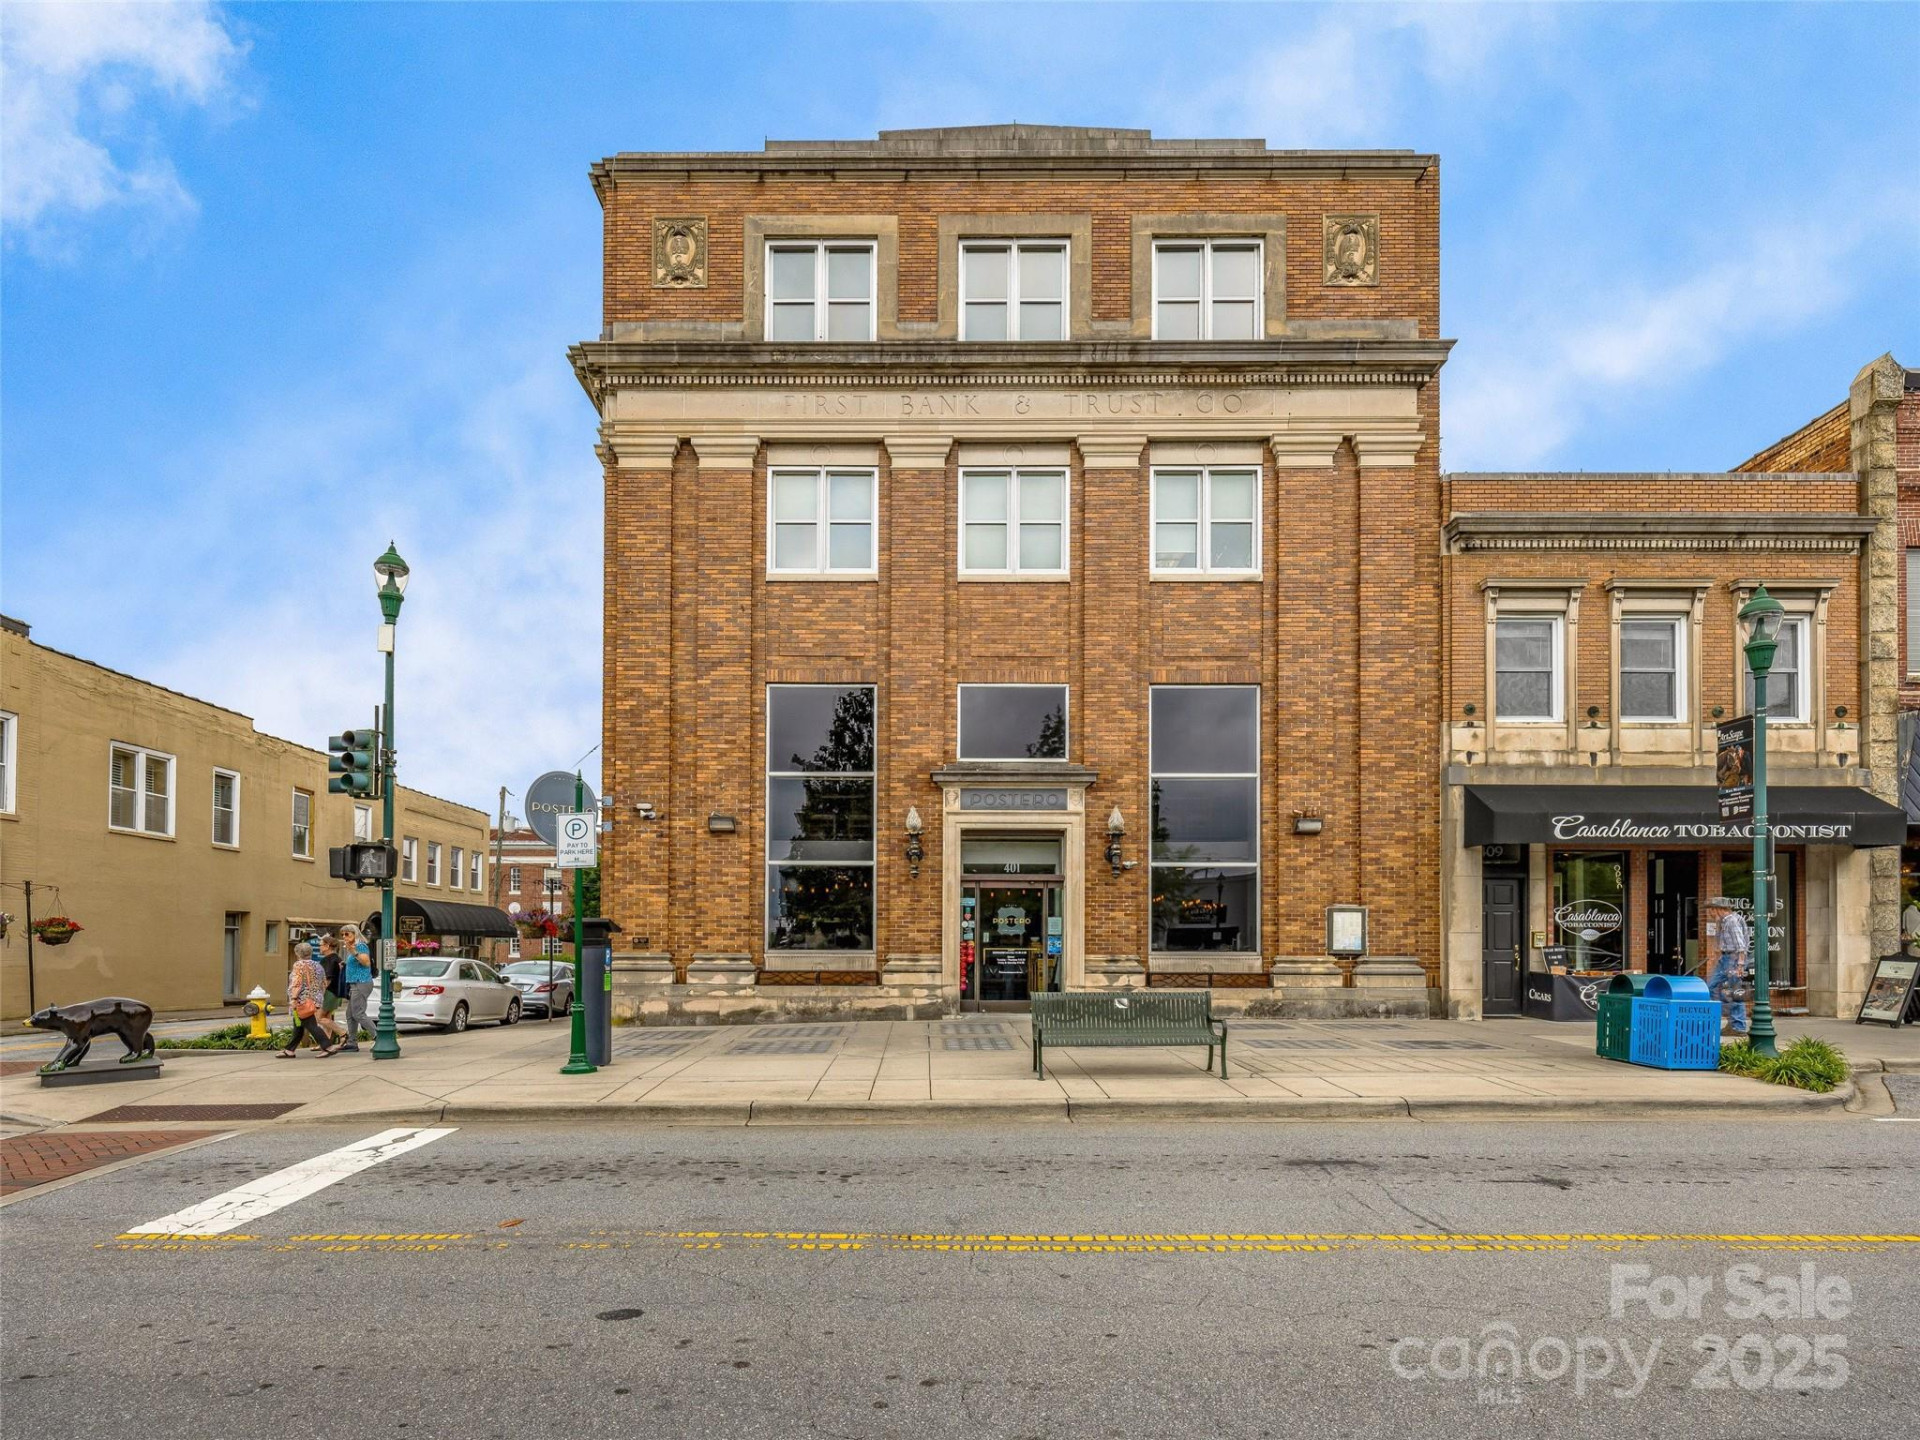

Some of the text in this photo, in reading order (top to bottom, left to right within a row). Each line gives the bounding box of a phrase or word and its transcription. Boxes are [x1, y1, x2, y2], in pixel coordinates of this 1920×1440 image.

[783, 394, 867, 415] FIRST
[901, 395, 982, 415] BANK
[1014, 396, 1032, 414] &
[1064, 393, 1163, 415] TRUST
[969, 793, 1059, 807] POSTERO
[1551, 815, 1852, 840] Casablanca TOBACONIST
[1004, 863, 1021, 873] 401
[1553, 905, 1620, 923] Casablanca
[992, 917, 1032, 925] POSTERO
[1638, 1003, 1663, 1013] RECYCLE
[1679, 1006, 1711, 1014] RECYCLE
